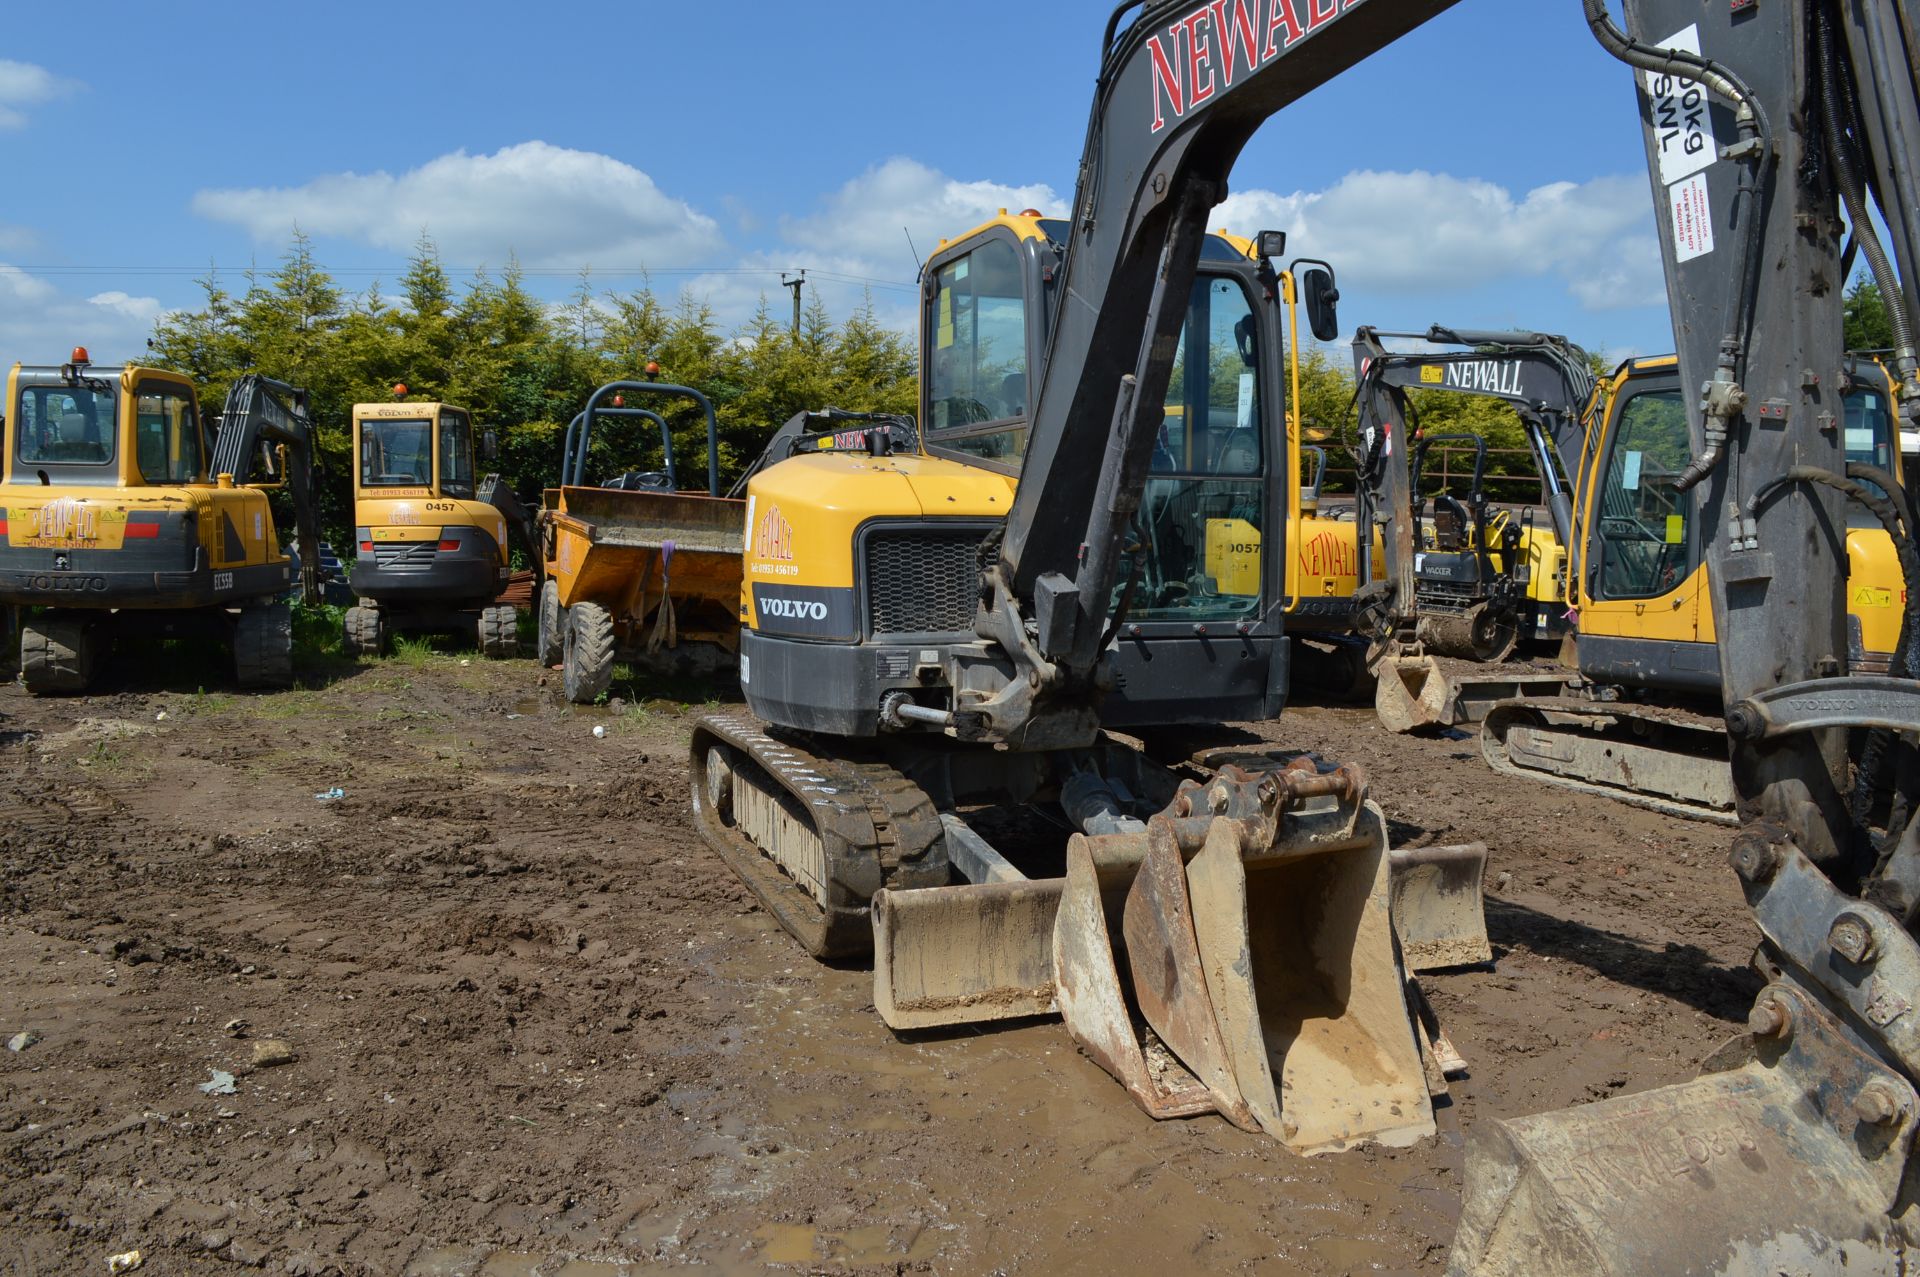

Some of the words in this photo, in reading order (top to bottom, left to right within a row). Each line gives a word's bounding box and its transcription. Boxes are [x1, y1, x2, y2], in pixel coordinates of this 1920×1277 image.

[1655, 75, 1679, 152] SWL
[1676, 203, 1684, 242] REQUIRED
[1446, 360, 1523, 396] NEWALL
[426, 503, 455, 512] 0457
[756, 504, 793, 560] NEWALL
[1299, 531, 1358, 576] NEWALL
[775, 564, 799, 576] 456119
[1425, 566, 1452, 576] WACKER
[16, 575, 110, 592] VOLVO
[760, 597, 828, 620] VOLVO
[1790, 698, 1858, 711] VOLVO
